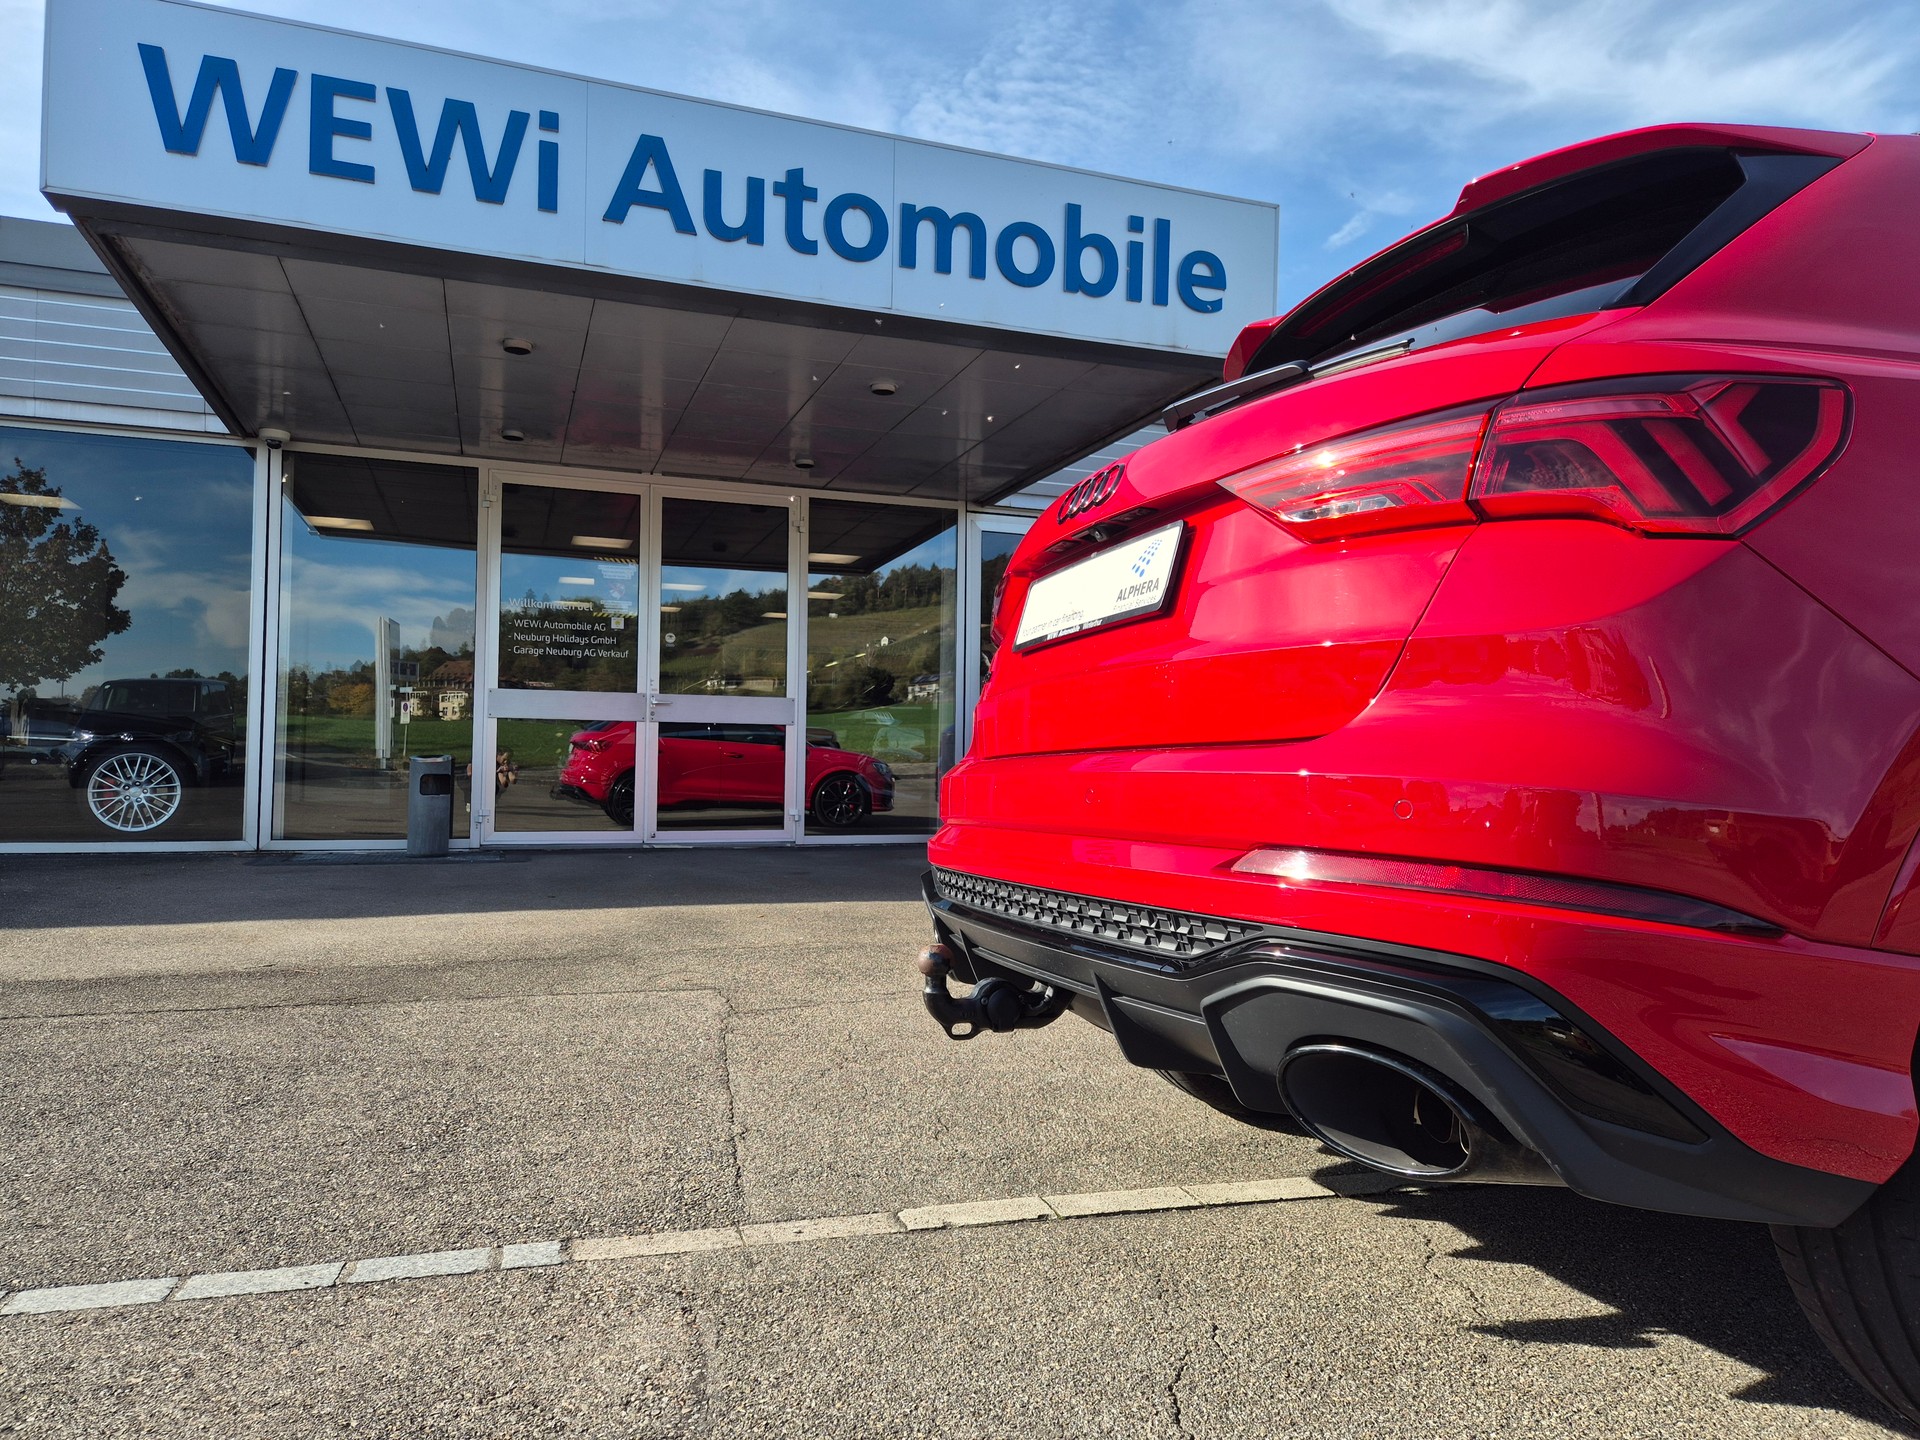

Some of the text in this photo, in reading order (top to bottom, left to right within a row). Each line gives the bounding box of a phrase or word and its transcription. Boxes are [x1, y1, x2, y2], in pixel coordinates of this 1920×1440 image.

[137, 42, 1227, 313] WEWi Automobile
[1116, 577, 1159, 602] ALPHERA
[509, 598, 575, 611] Willkommen
[577, 601, 594, 611] bei
[514, 619, 606, 632] WEWi Automobile AG
[513, 632, 617, 646] Neuburg Holidays GmbH
[513, 646, 629, 659] Garage Neuburg AG Verkauf
